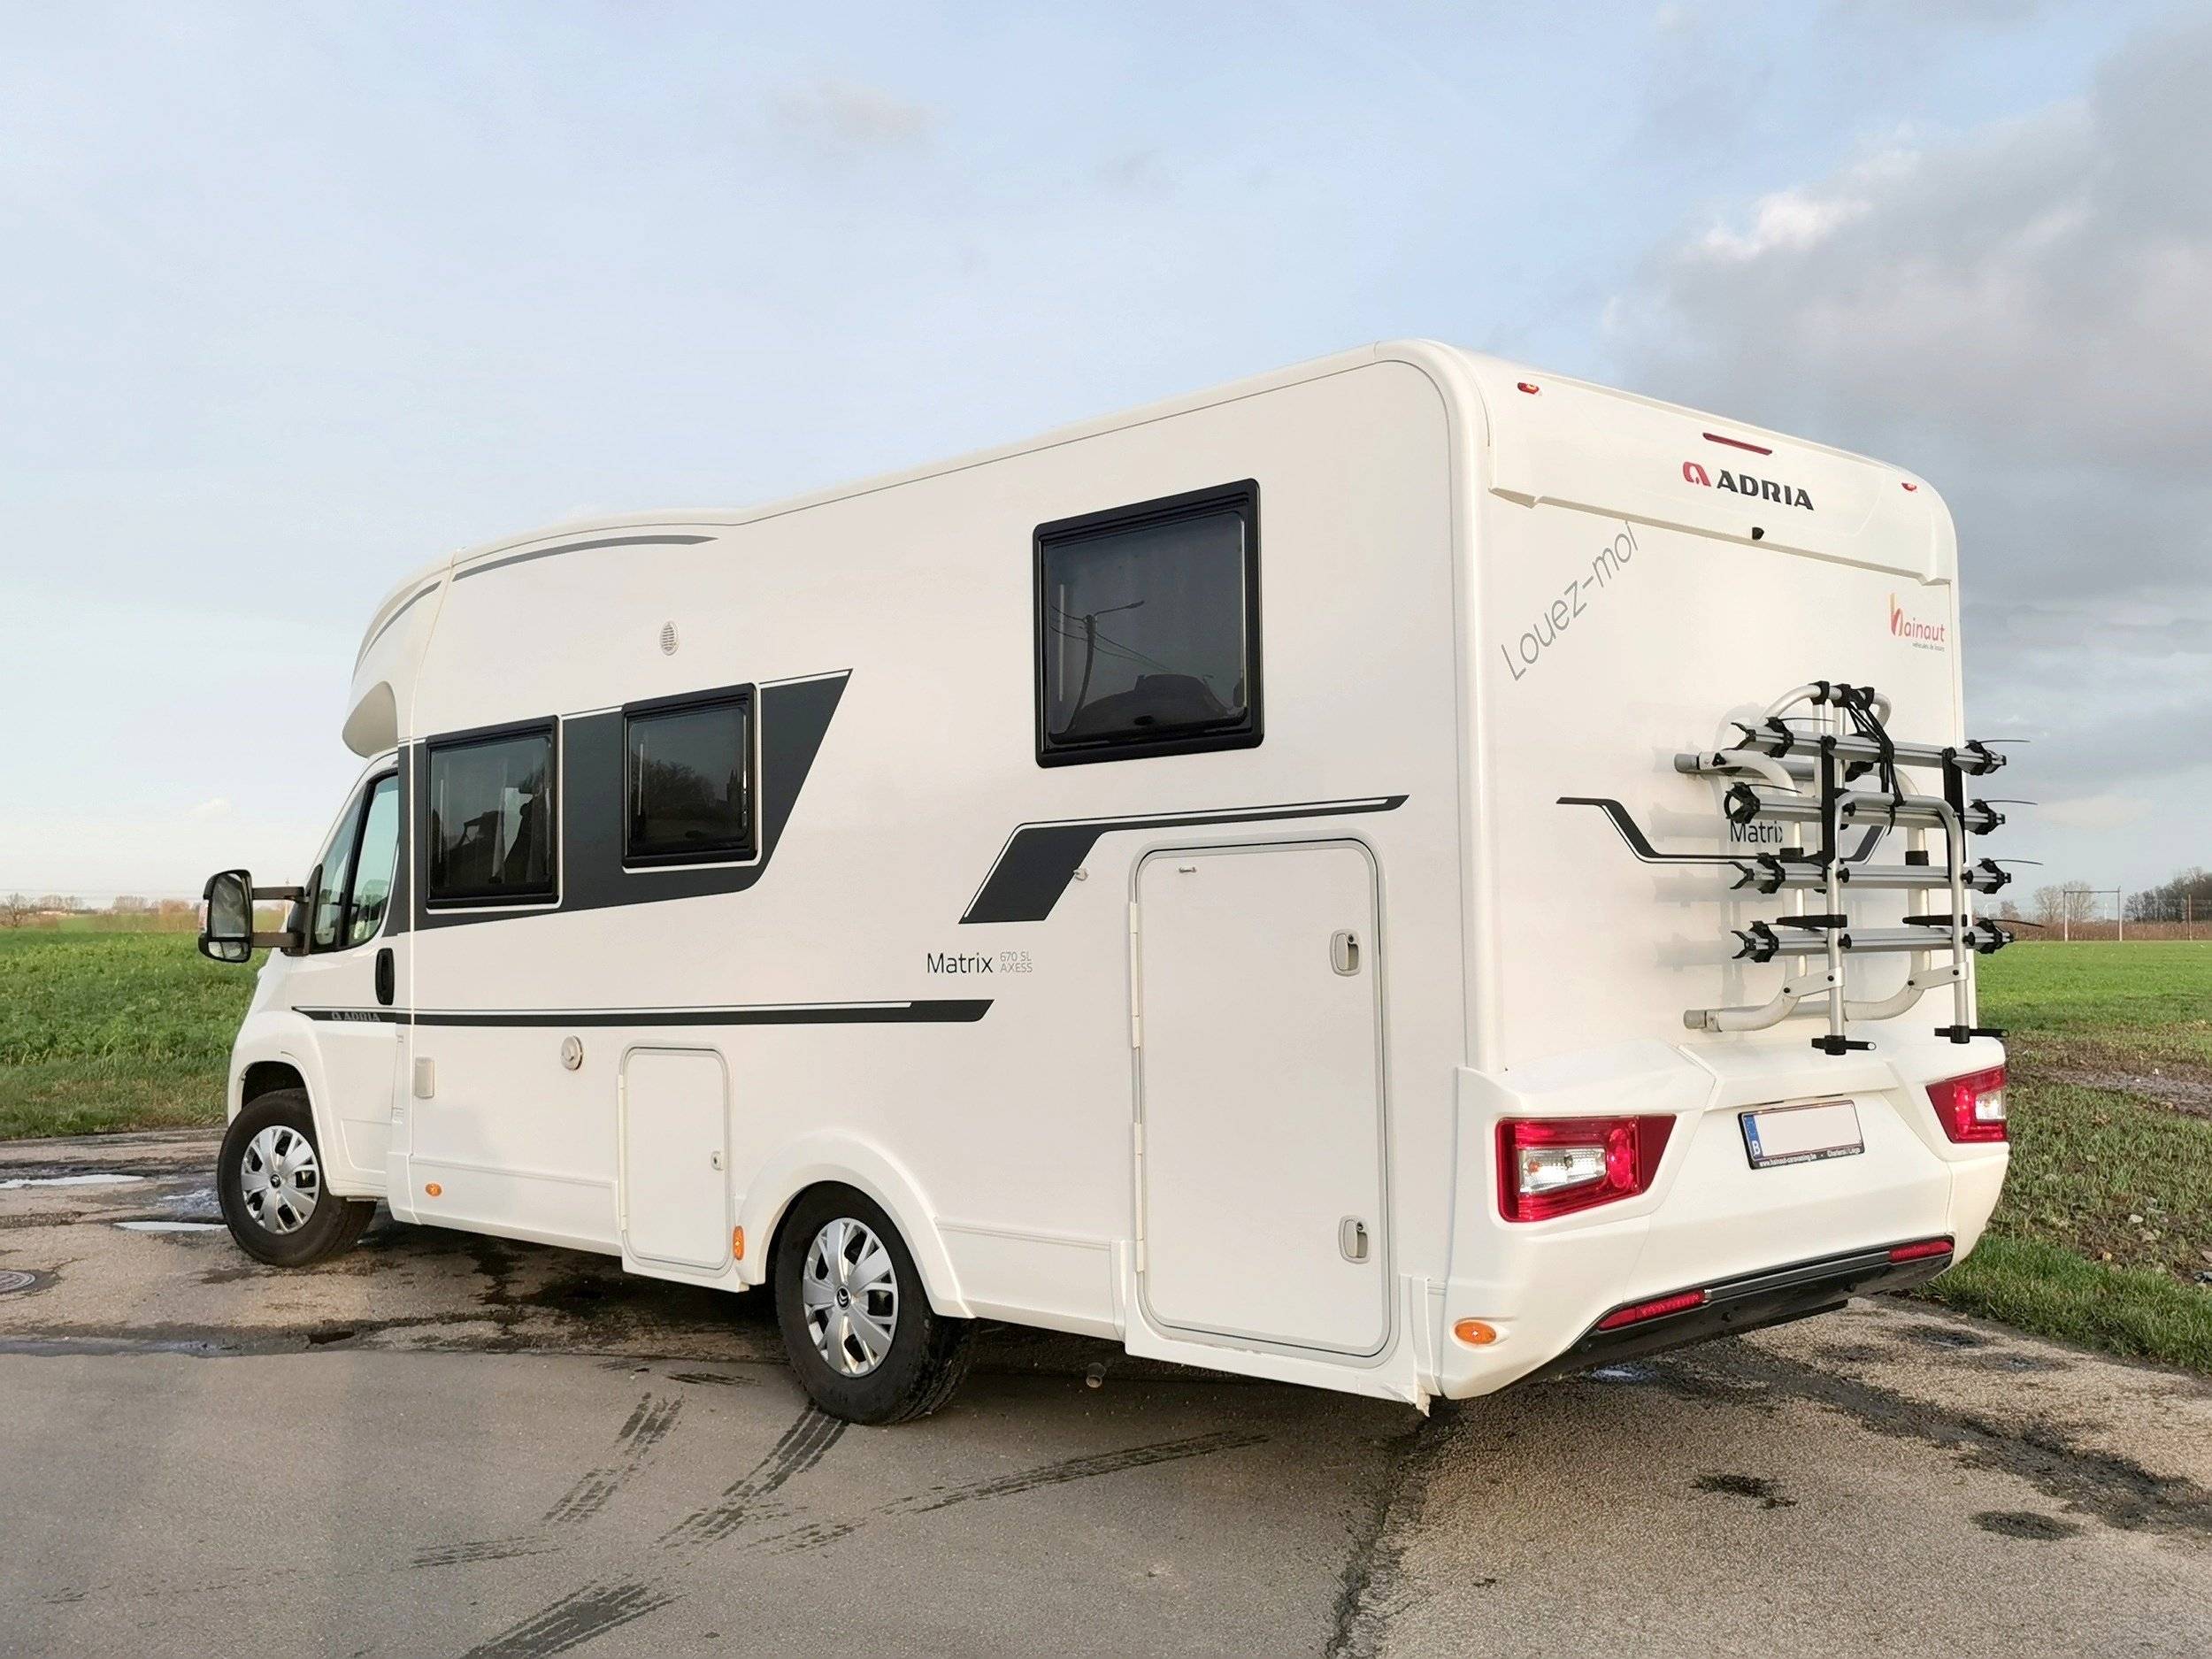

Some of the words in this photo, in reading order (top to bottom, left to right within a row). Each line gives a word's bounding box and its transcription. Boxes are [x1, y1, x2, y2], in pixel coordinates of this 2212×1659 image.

[1717, 469, 1815, 511] ADRIA
[1501, 519, 1639, 681] Louez-moi
[1889, 592, 1946, 642] hainaut
[926, 952, 994, 973] Matrix
[1000, 951, 1018, 962] 670
[1020, 951, 1032, 962] SL
[1000, 962, 1033, 973] AXESS
[343, 1011, 381, 1023] ADRIA
[1752, 1140, 1761, 1156] B
